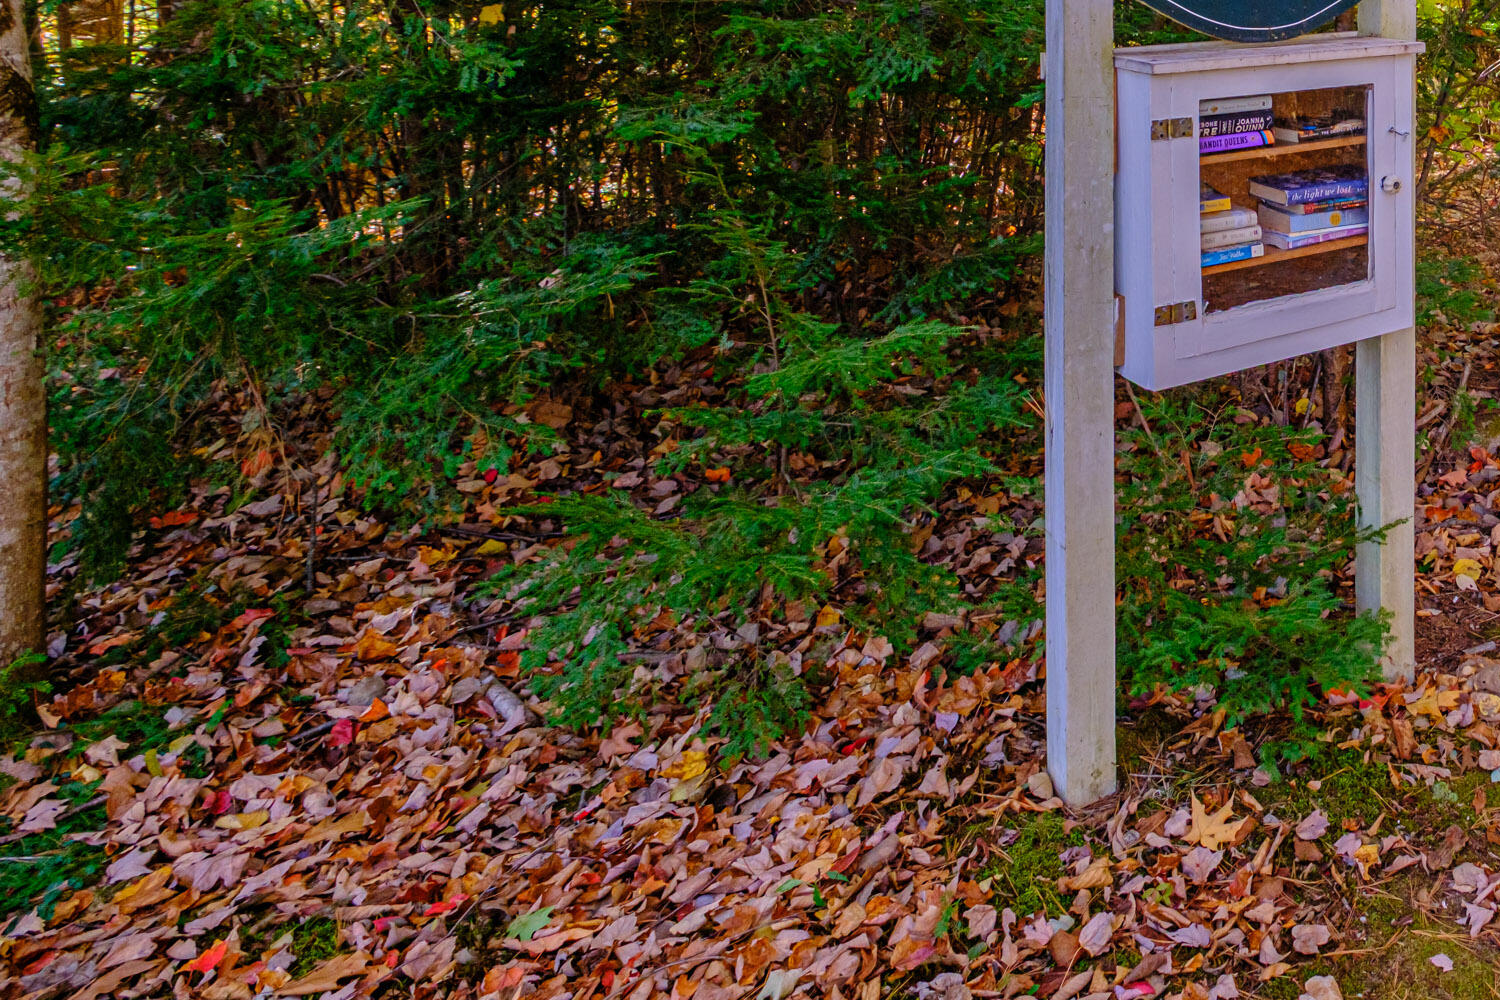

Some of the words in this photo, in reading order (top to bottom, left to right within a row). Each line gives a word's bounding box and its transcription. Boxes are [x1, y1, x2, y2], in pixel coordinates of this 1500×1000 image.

[1236, 116, 1264, 126] JOANNA
[1235, 123, 1264, 133] QUINN
[1224, 135, 1248, 147] QUEENS
[1291, 193, 1302, 201] the
[1303, 187, 1324, 202] light
[1324, 188, 1335, 197] we
[1336, 184, 1352, 195] lost
